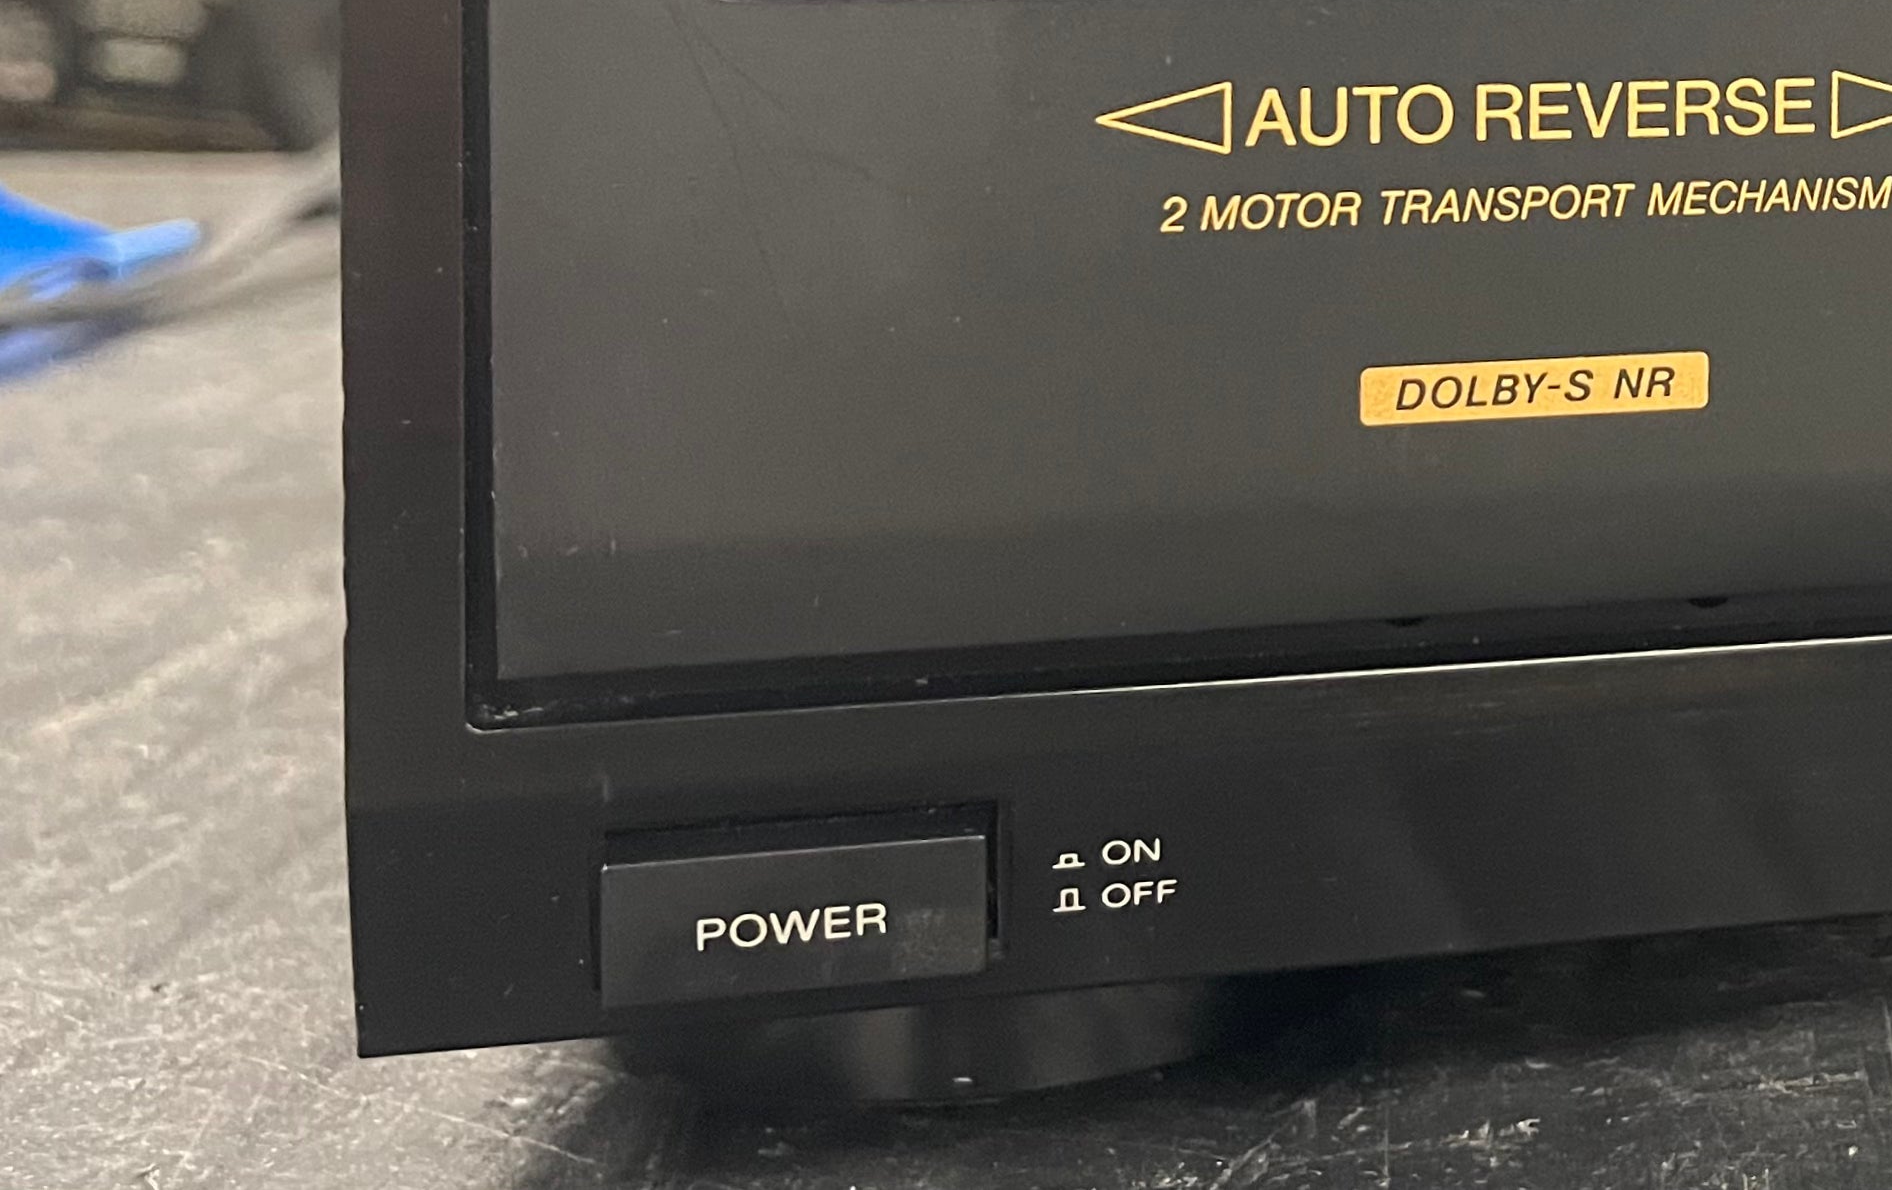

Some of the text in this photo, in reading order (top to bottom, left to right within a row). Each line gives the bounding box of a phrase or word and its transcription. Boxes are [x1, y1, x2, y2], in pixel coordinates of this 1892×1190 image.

[1244, 77, 1816, 147] AUTO REVERSE
[1160, 195, 1189, 233] 2
[1200, 190, 1362, 232] MOTOR
[1380, 182, 1636, 225] TRANSPORT
[1395, 366, 1676, 412] DOLBY-S NR
[1101, 837, 1162, 866] ON
[1101, 879, 1178, 910] OFF
[696, 902, 888, 952] POWER
